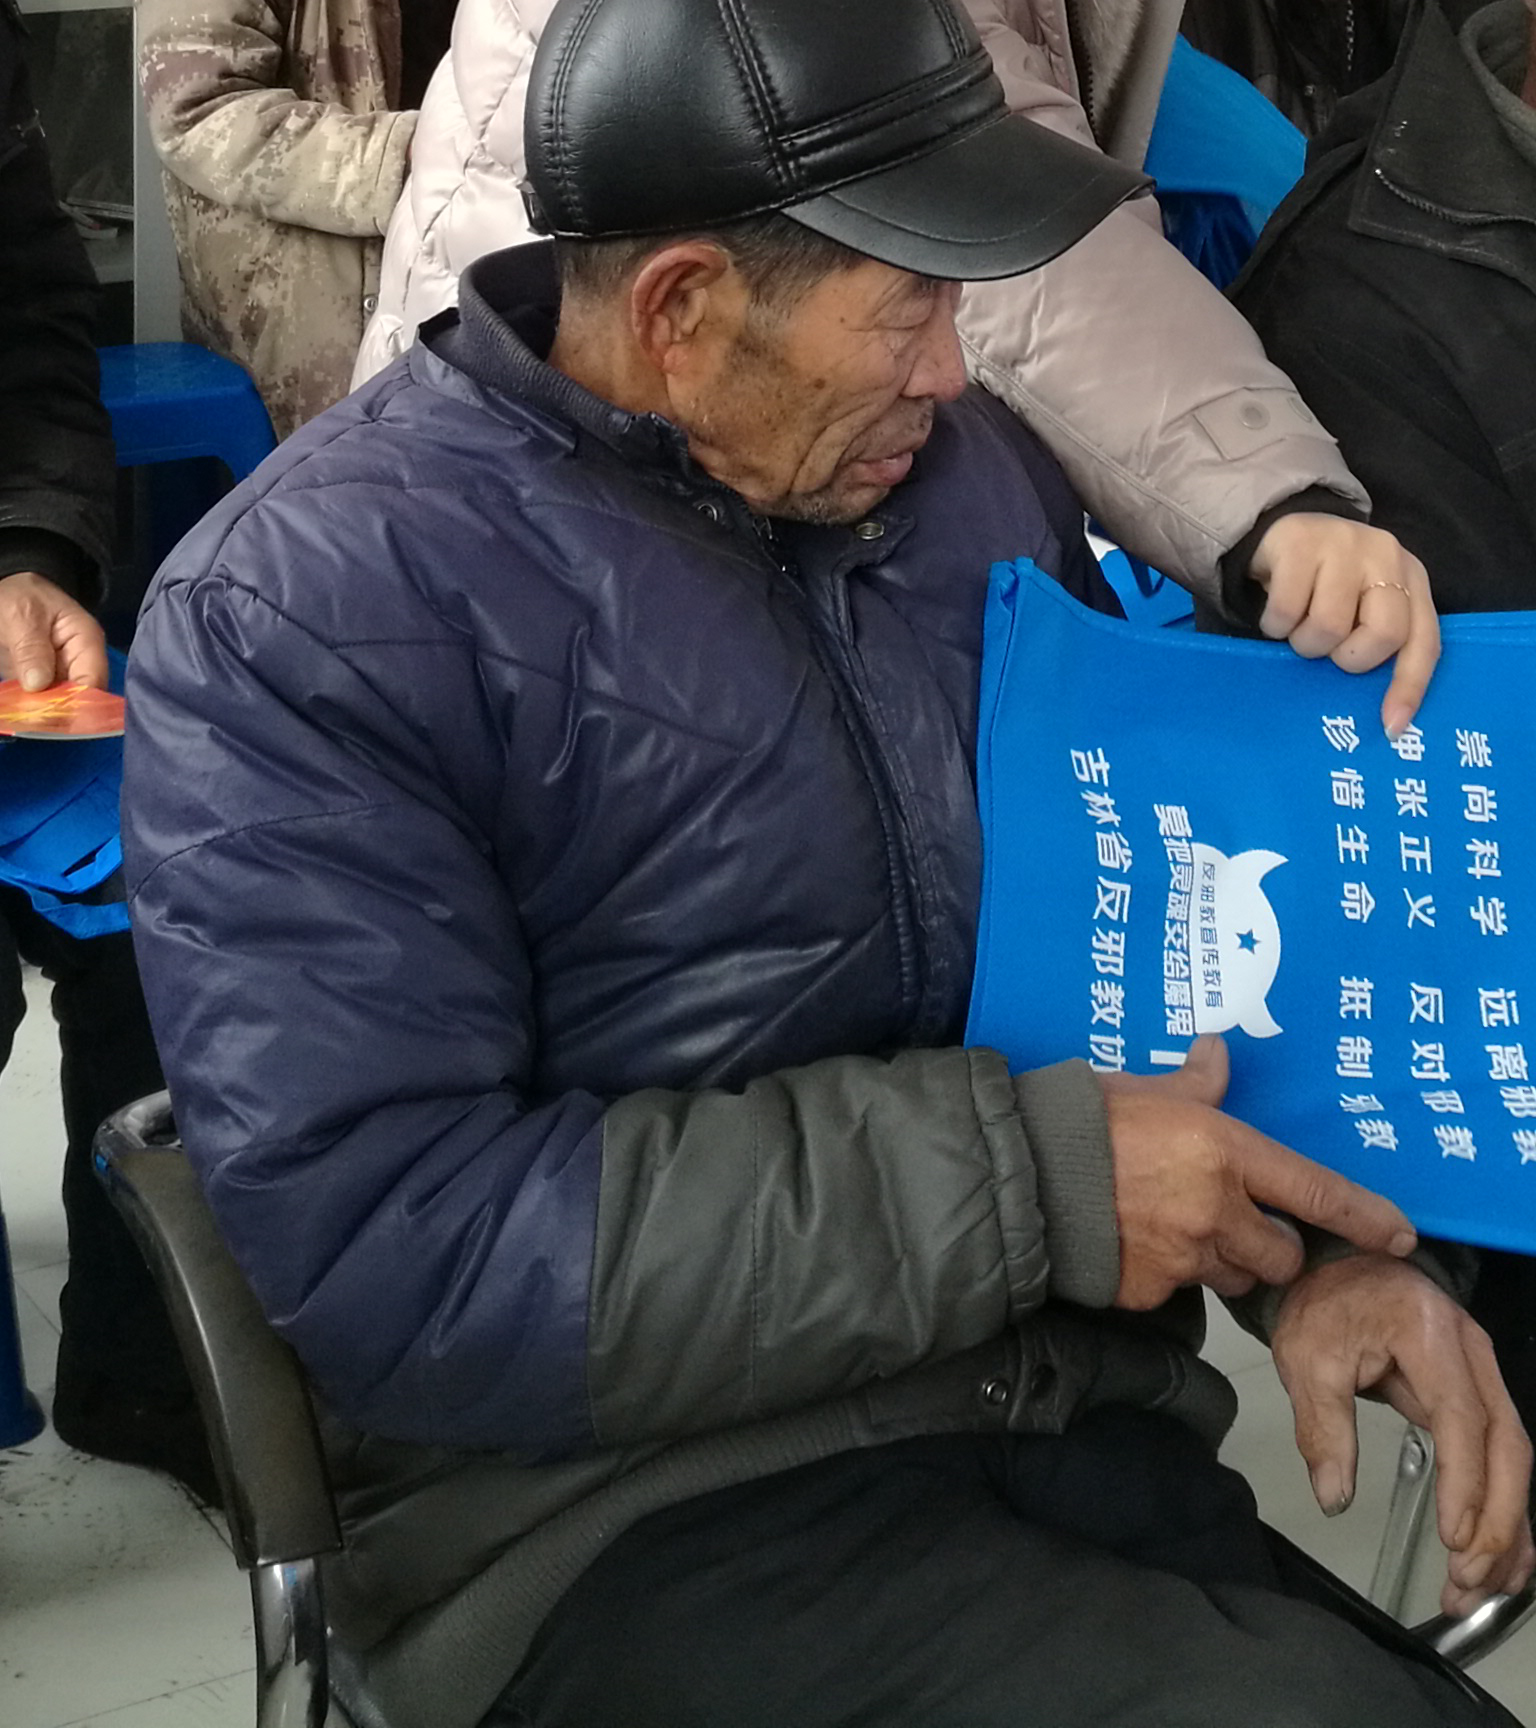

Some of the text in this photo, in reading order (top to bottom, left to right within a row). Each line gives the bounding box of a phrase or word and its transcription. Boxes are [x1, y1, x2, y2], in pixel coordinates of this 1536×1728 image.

[1199, 861, 1224, 1009] 反邪教宣传教育
[1322, 715, 1399, 1151] 珍惜生命 抵制邪教
[1385, 724, 1478, 1161] 伸张正义 反对邪教
[1454, 728, 1509, 936] 崇尚科学
